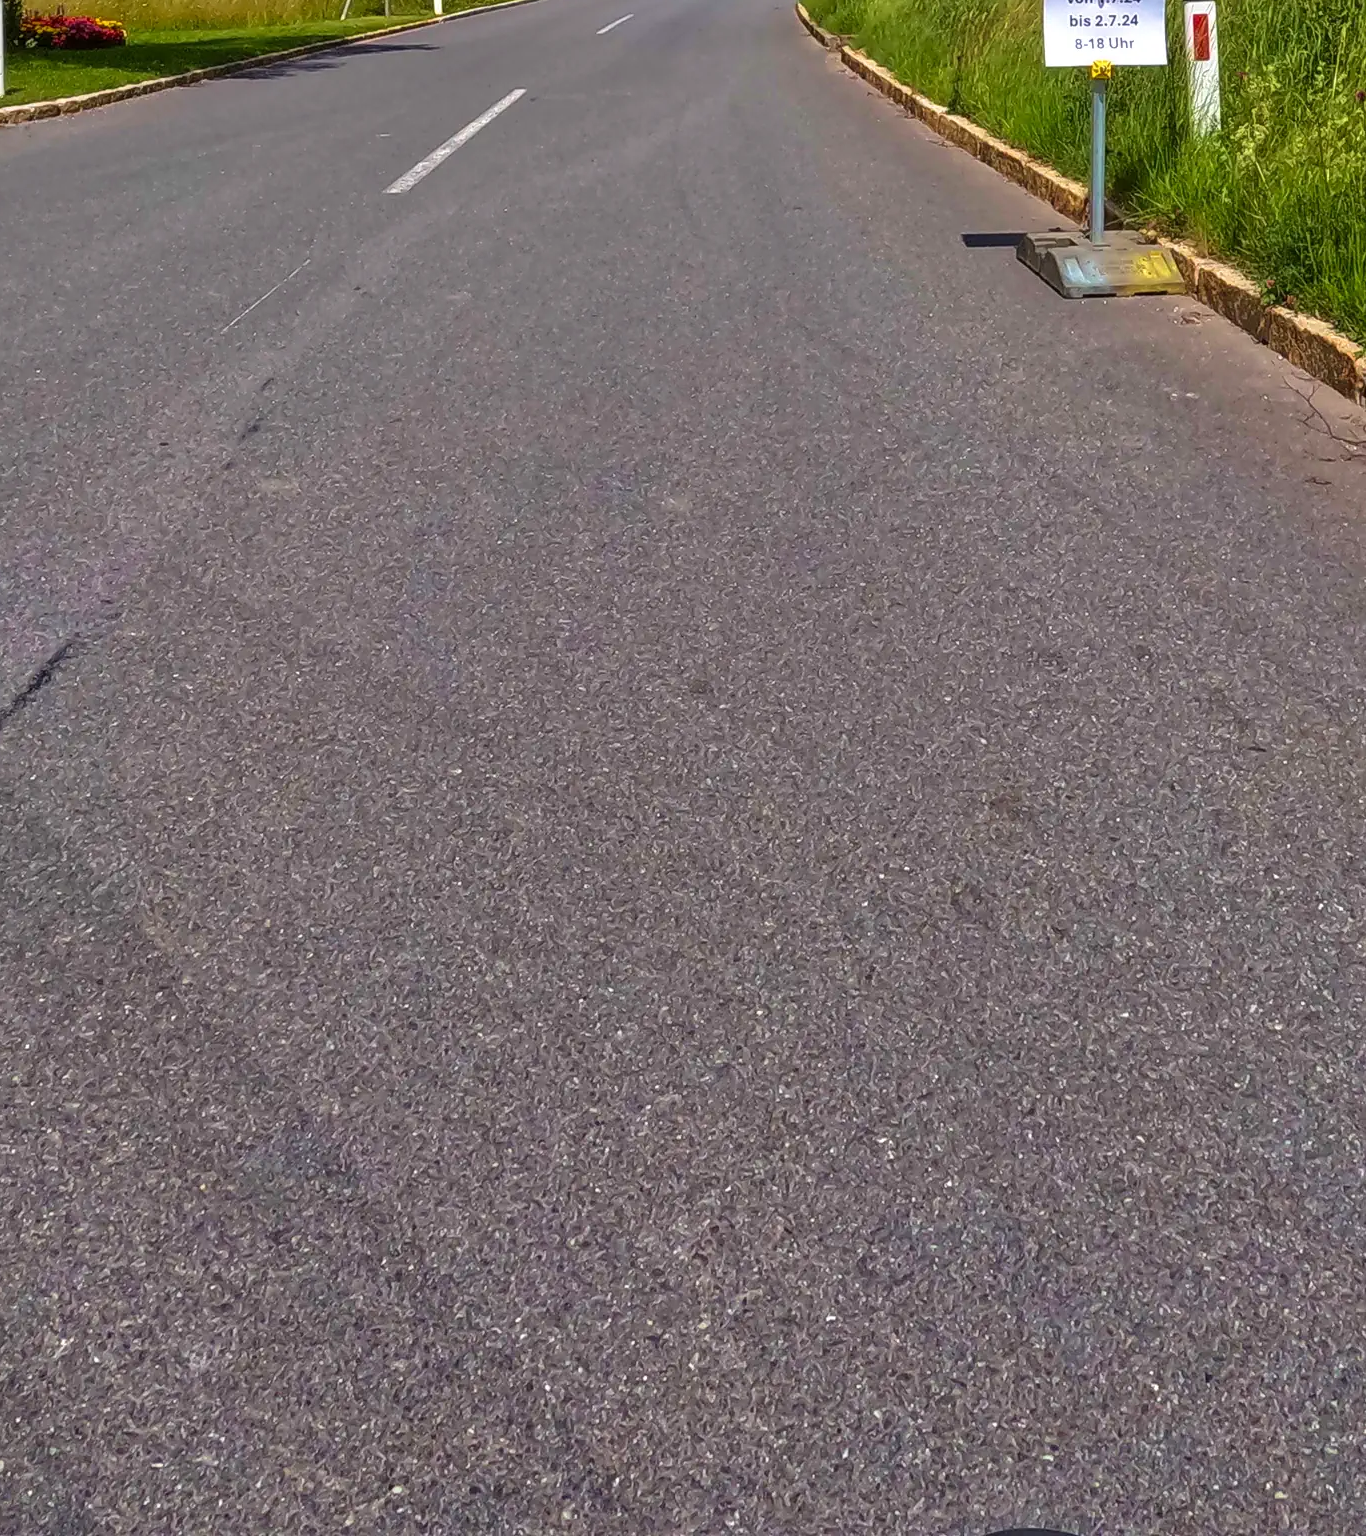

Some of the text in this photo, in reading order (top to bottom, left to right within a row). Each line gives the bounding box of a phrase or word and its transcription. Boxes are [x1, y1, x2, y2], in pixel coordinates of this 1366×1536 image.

[1069, 15, 1139, 27] bis 2.7.24
[1075, 37, 1134, 49] 8-18 Uhr
